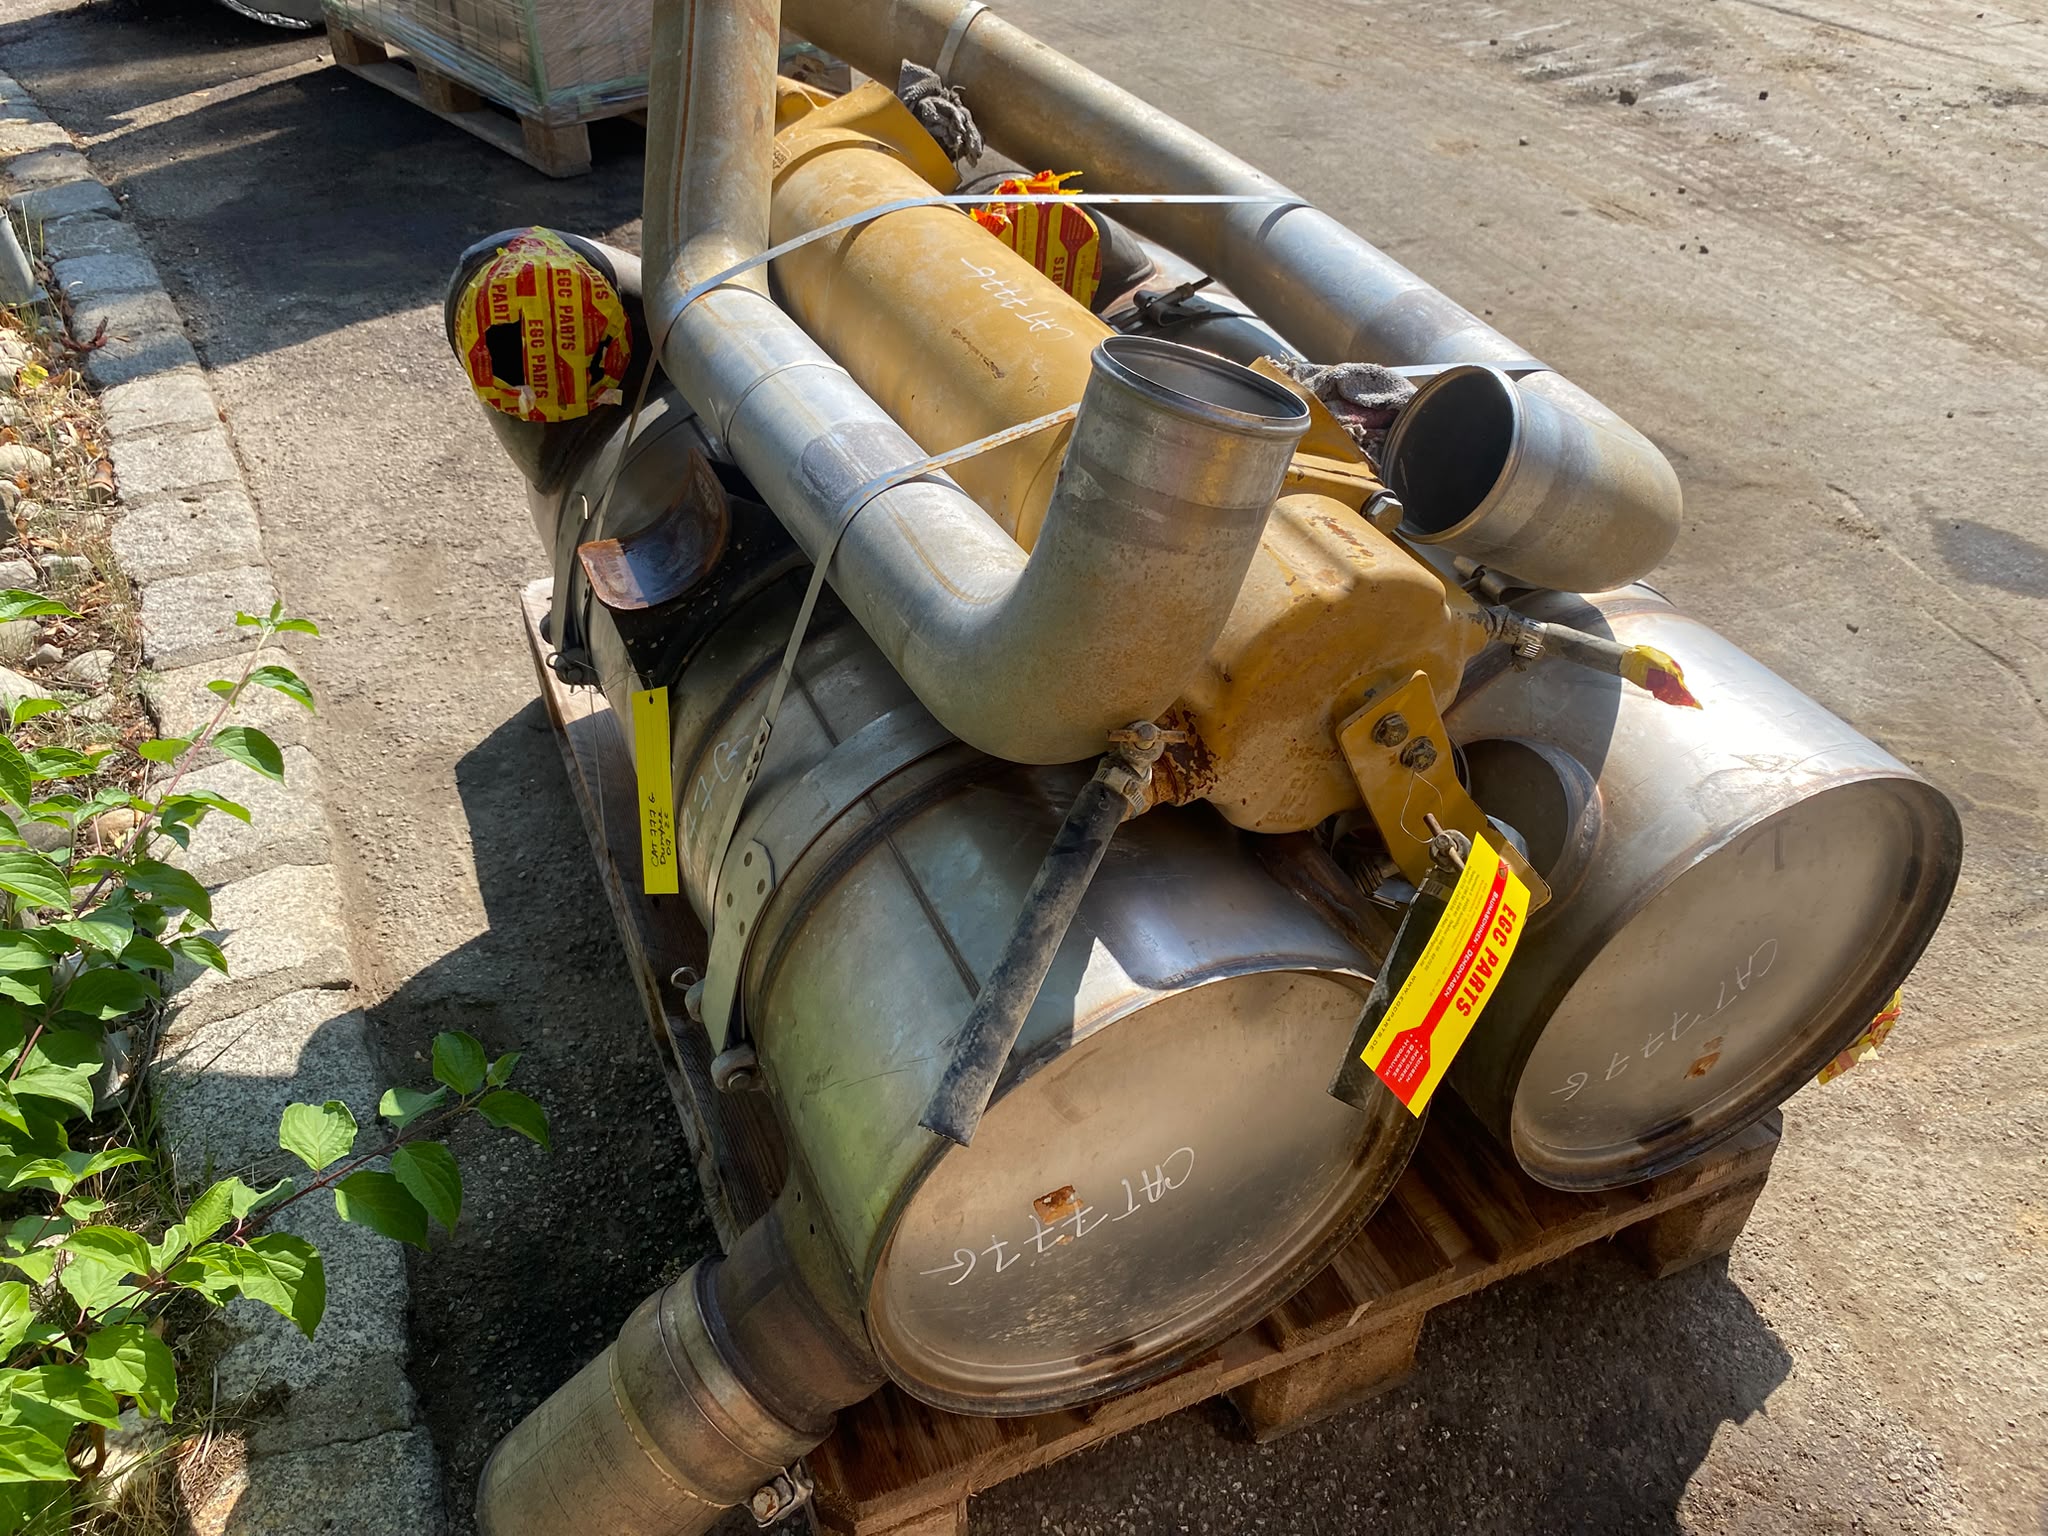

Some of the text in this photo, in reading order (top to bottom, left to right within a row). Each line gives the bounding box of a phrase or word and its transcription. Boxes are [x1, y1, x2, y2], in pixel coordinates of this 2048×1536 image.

[492, 284, 510, 322] PART
[556, 268, 576, 351] EGC PARTS
[1015, 310, 1074, 341] CAT
[528, 319, 549, 399] EGC PARTS
[651, 841, 660, 868] CAT
[1472, 890, 1499, 945] BAUMASCHINEN
[1493, 903, 1517, 947] EGC
[1443, 950, 1474, 999] DEMONTAGEN
[1455, 949, 1499, 1017] PARTS
[1700, 938, 1778, 1024] CAT
[1398, 1049, 1419, 1083] MOTOREN
[1405, 1053, 1424, 1083] ACHSEN
[1112, 1146, 1194, 1222] CAT
